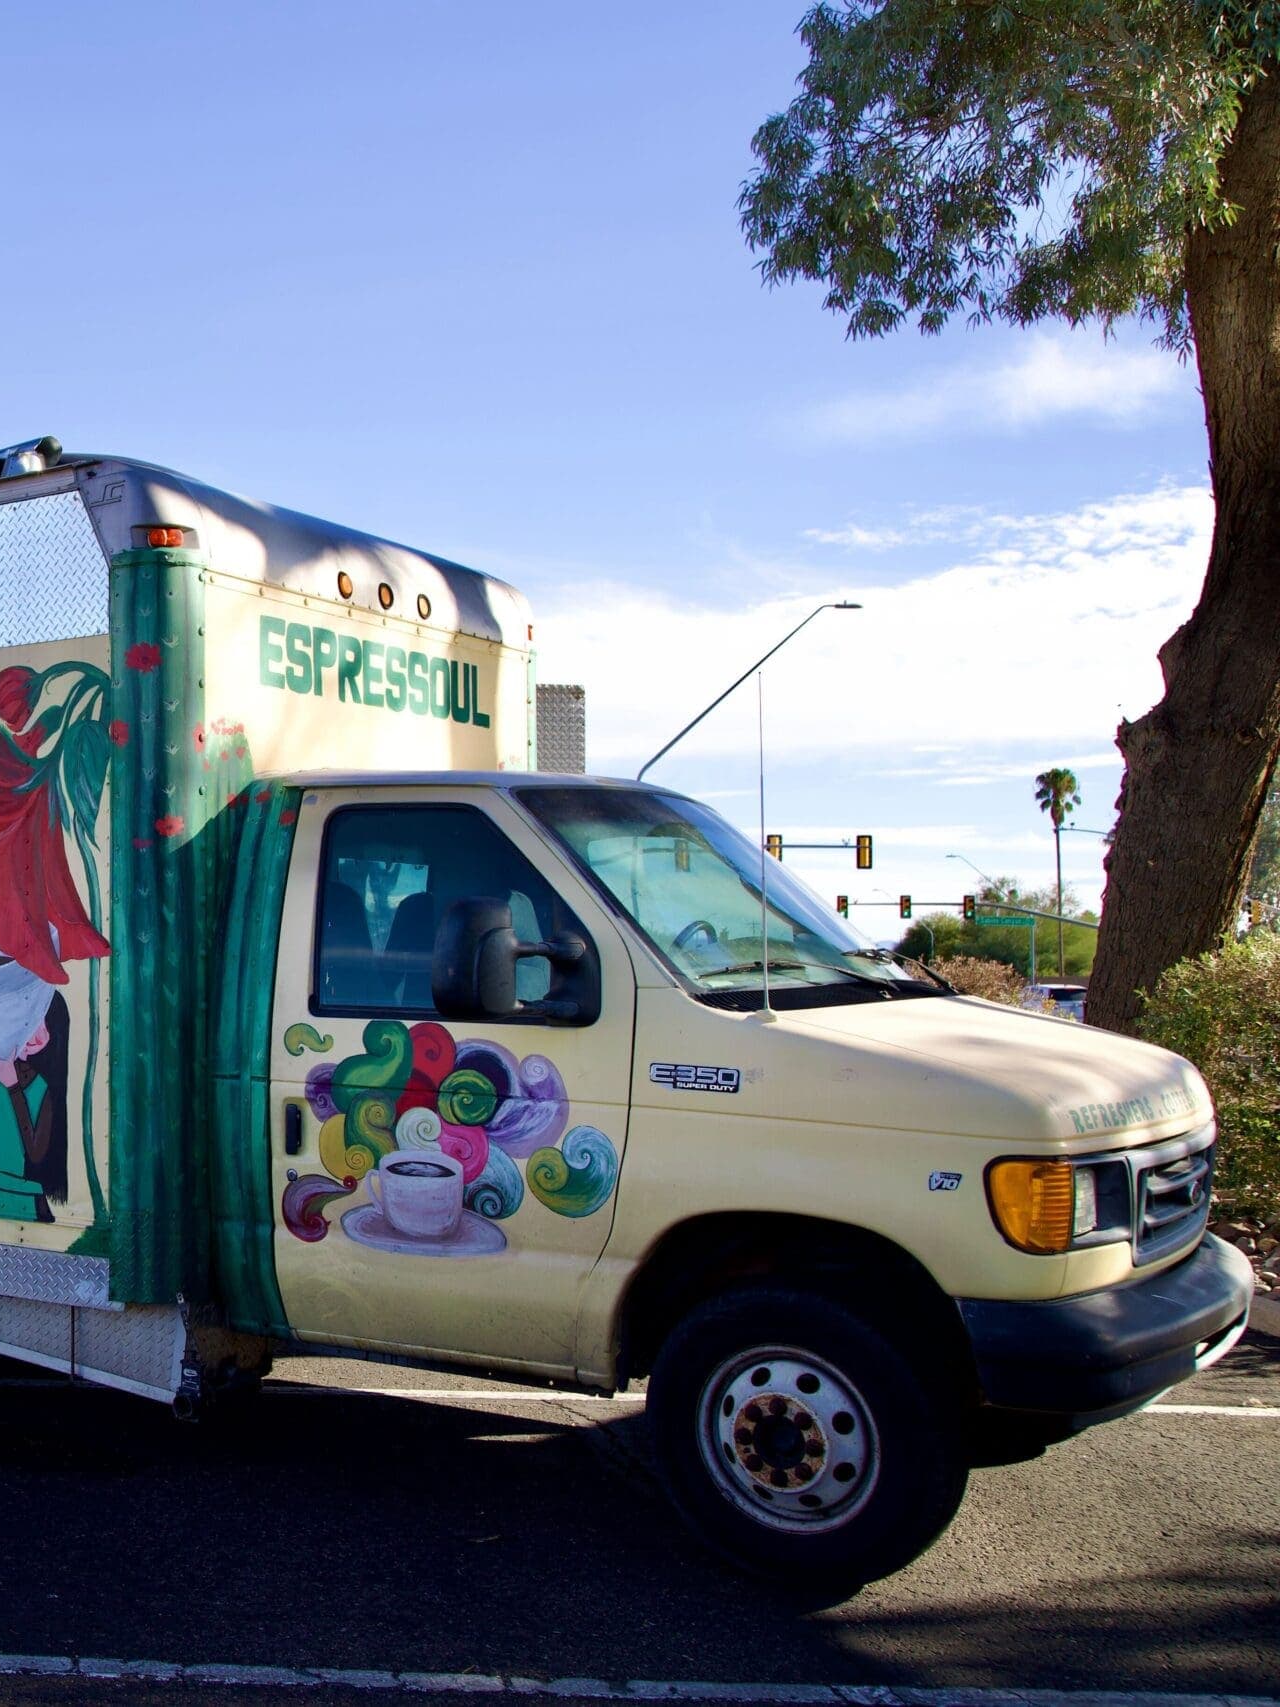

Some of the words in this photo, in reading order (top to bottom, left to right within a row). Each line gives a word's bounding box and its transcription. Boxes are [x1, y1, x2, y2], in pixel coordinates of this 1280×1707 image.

[260, 614, 490, 729] ESPRESSOUL
[676, 1081, 708, 1089] SUPER
[930, 1176, 959, 1190] V10
